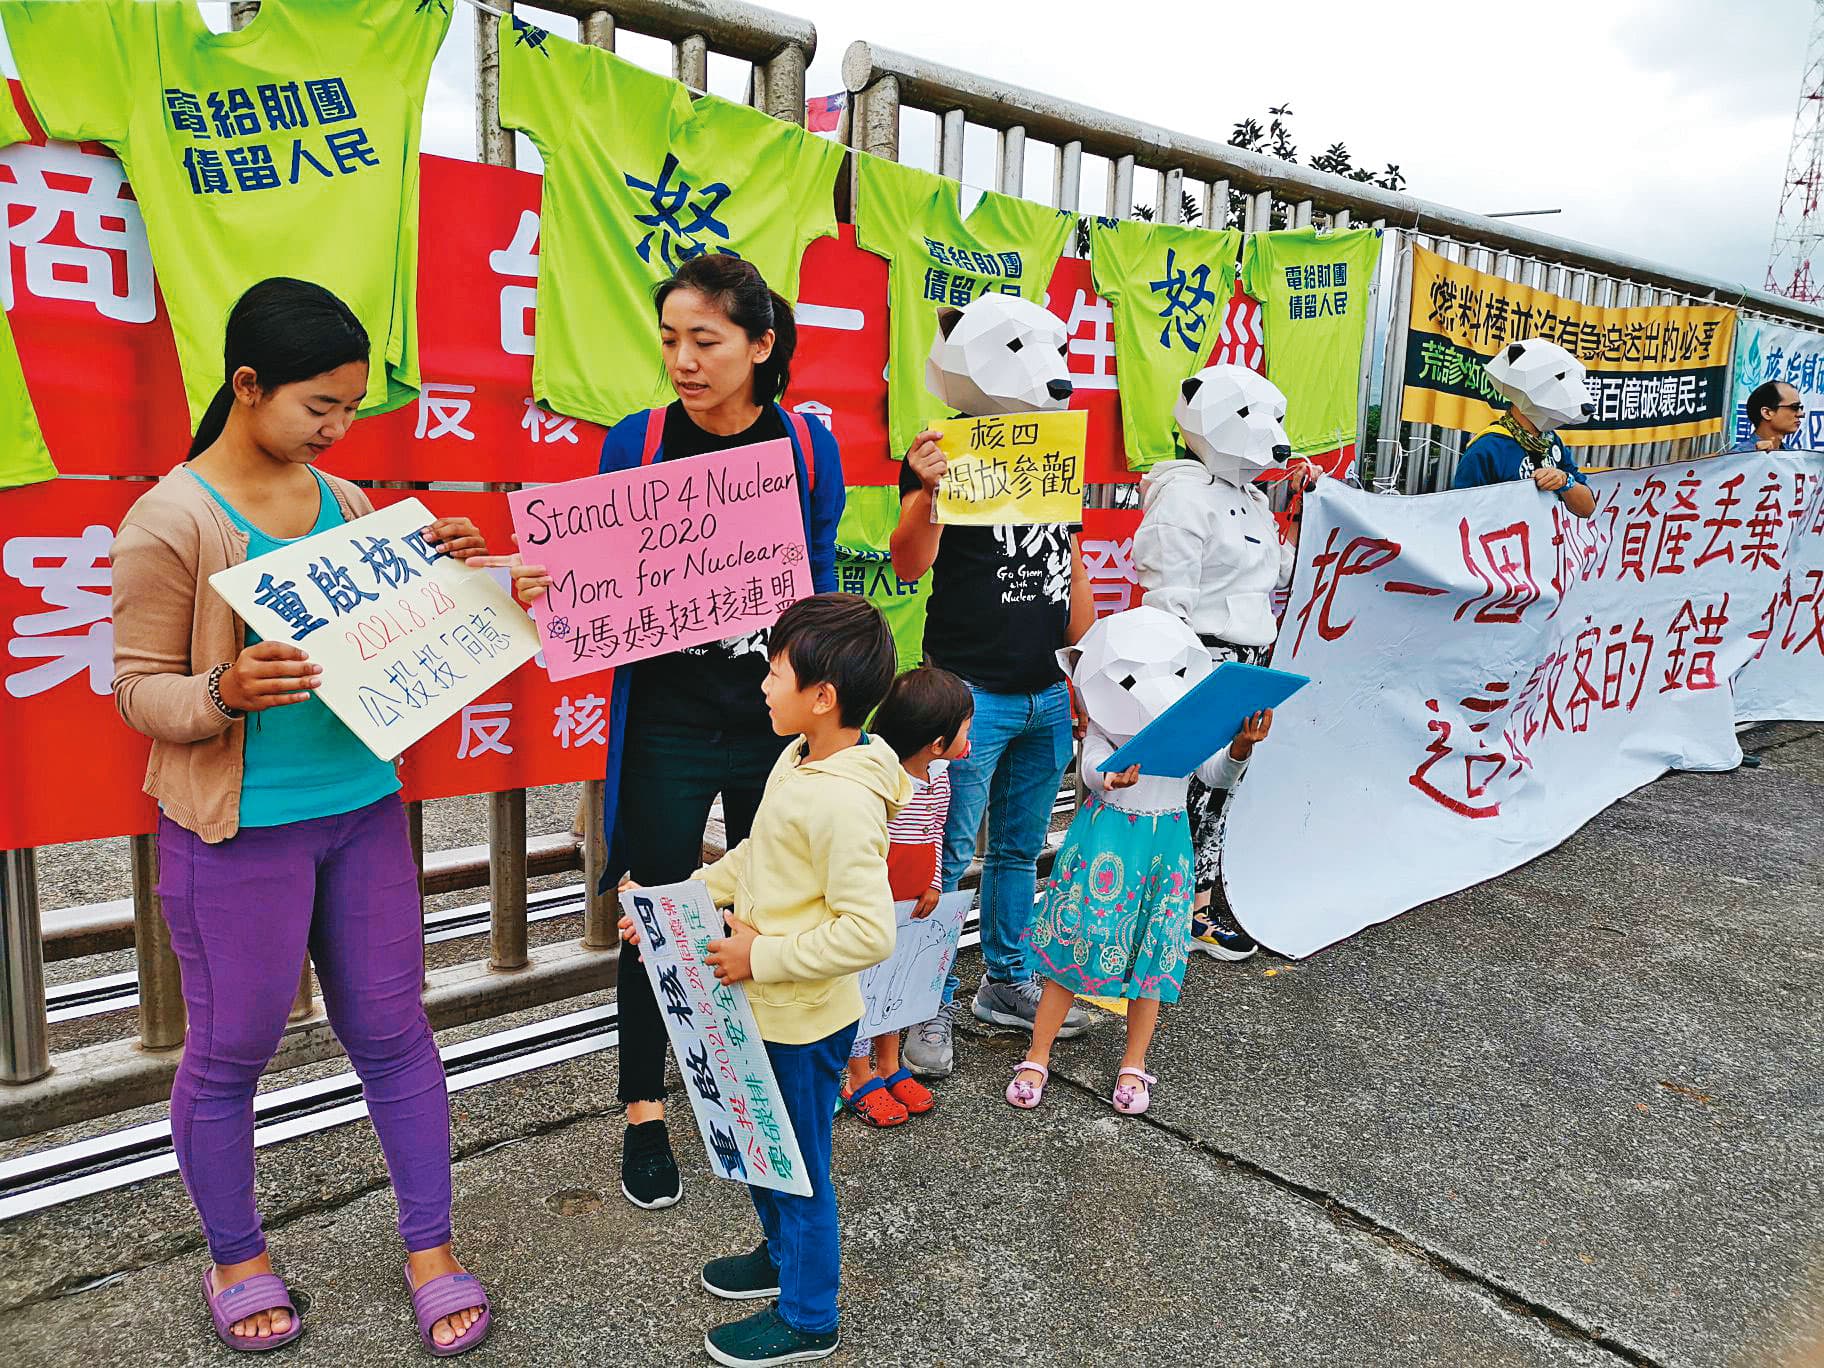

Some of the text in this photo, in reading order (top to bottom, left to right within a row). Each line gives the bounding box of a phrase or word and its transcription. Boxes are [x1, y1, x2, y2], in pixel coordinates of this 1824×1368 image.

[165, 77, 358, 140] 電給財團
[182, 127, 380, 195] 債留人民
[923, 235, 1023, 279] 電給財團
[1285, 262, 1348, 291] 電給財團
[1149, 247, 1216, 354] 怒
[1289, 291, 1348, 321] 債留人民
[415, 382, 476, 442] 反
[970, 417, 1039, 450] 核四
[525, 461, 796, 546] Stand UP 4 Nuclear
[943, 450, 1081, 504] 開放參觀
[638, 513, 719, 554] 2020
[253, 525, 455, 642] 重啟核四
[543, 540, 784, 614] Mom for Nuclear
[996, 566, 1014, 580] Go
[1001, 589, 1038, 604] Nuclear
[344, 581, 456, 661] 2021.8.28
[565, 568, 797, 664] 媽媽挺核連盟
[456, 693, 607, 760] 反 核
[633, 894, 748, 1180] 重啟核四
